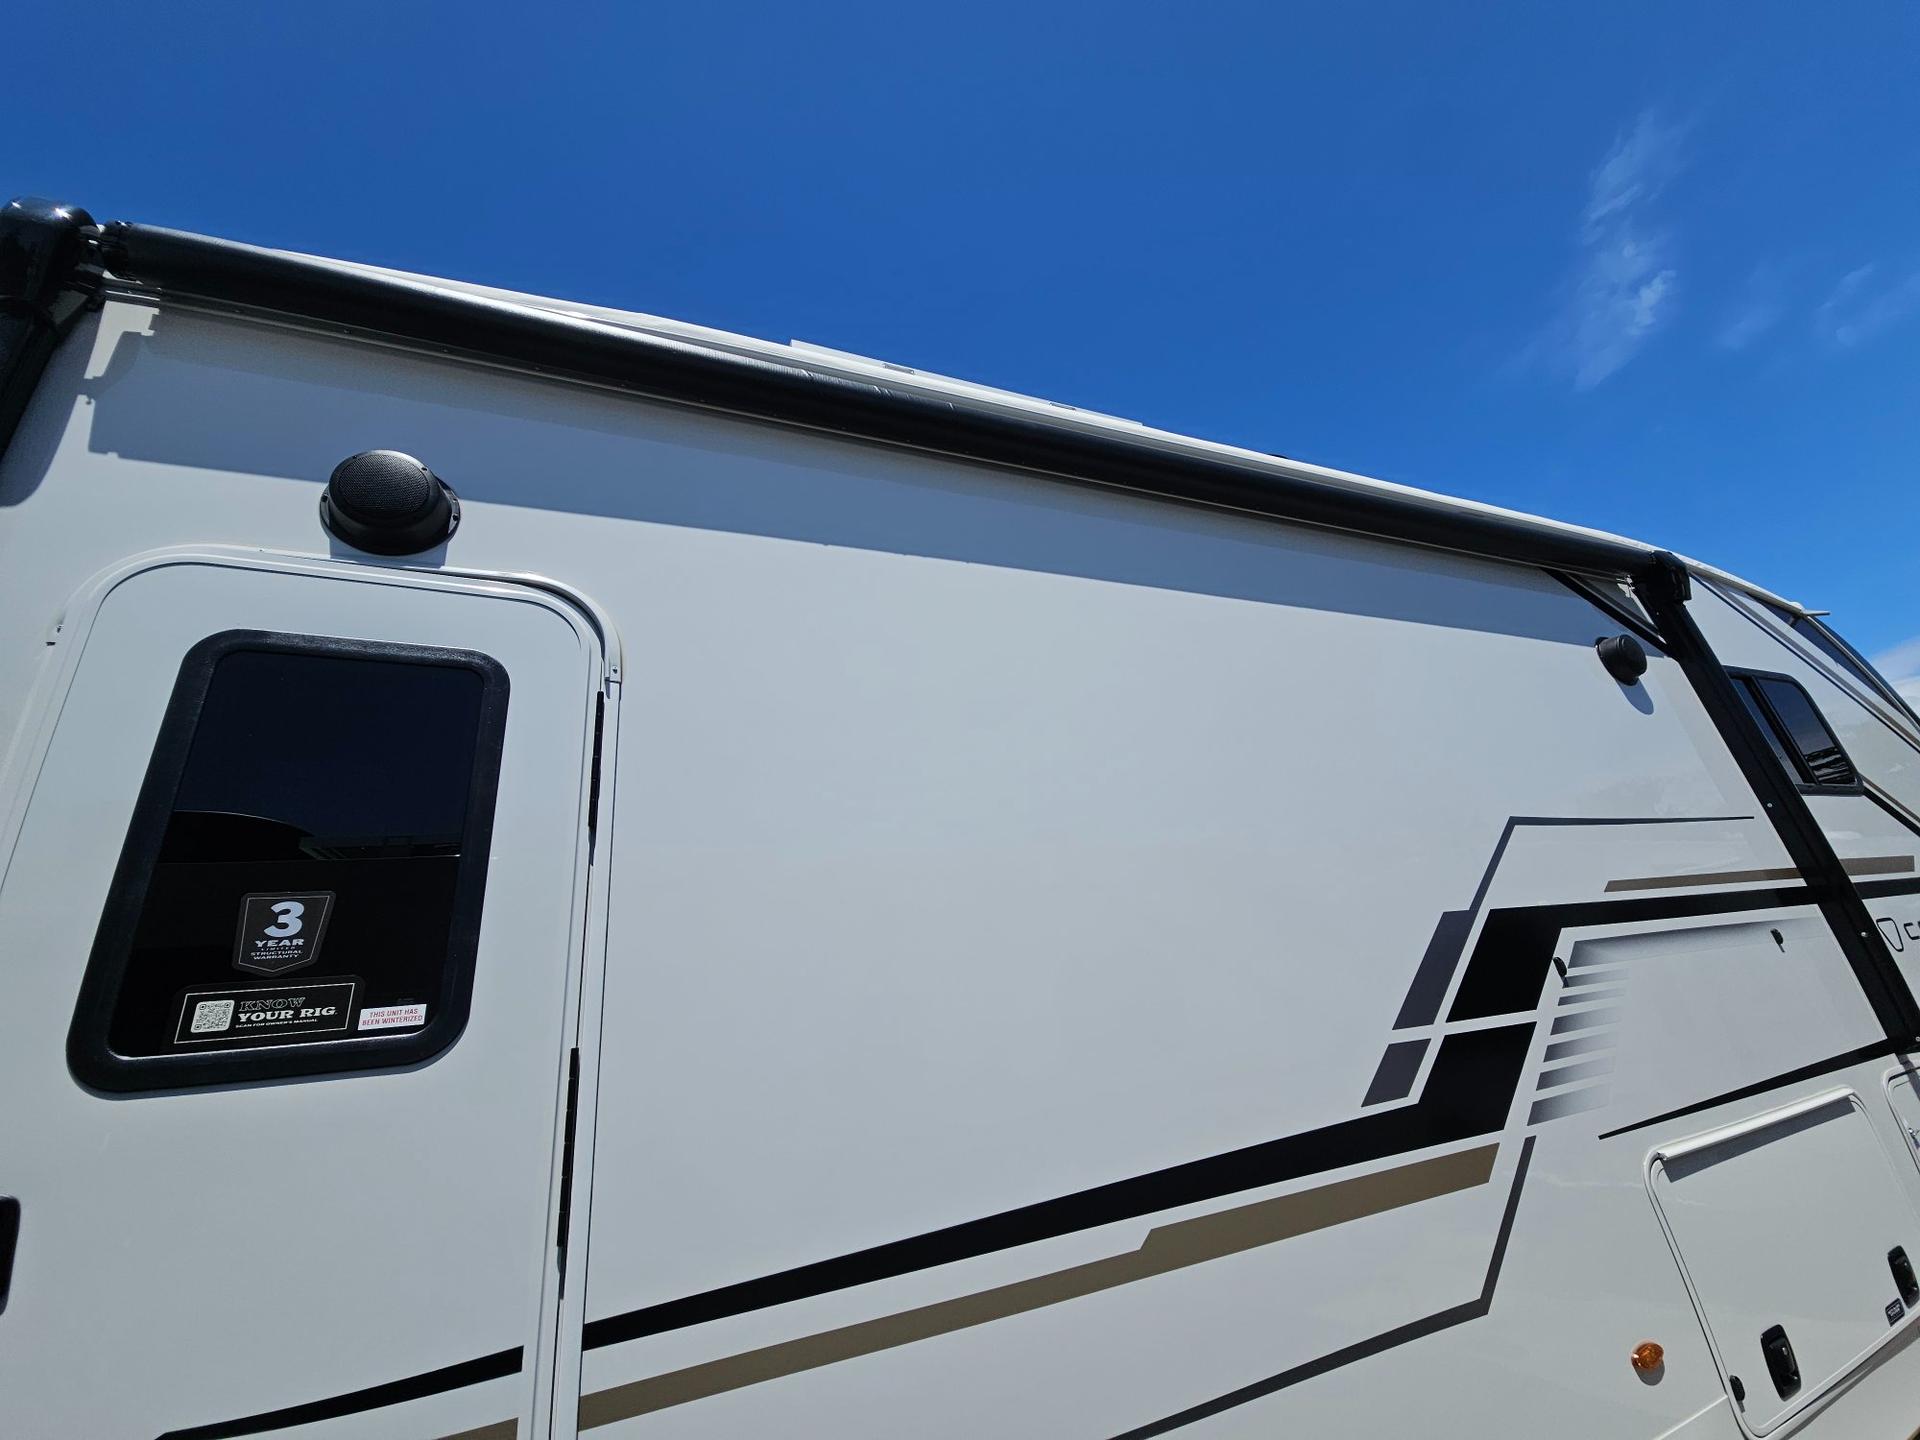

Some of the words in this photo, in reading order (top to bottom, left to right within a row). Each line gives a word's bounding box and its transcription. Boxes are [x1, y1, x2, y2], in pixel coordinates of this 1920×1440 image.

[264, 901, 304, 938] 3
[255, 939, 304, 948] YEAR
[239, 996, 306, 1011] KNOW
[238, 1010, 294, 1022] YOUR
[382, 1015, 423, 1024] WINTERIZED
